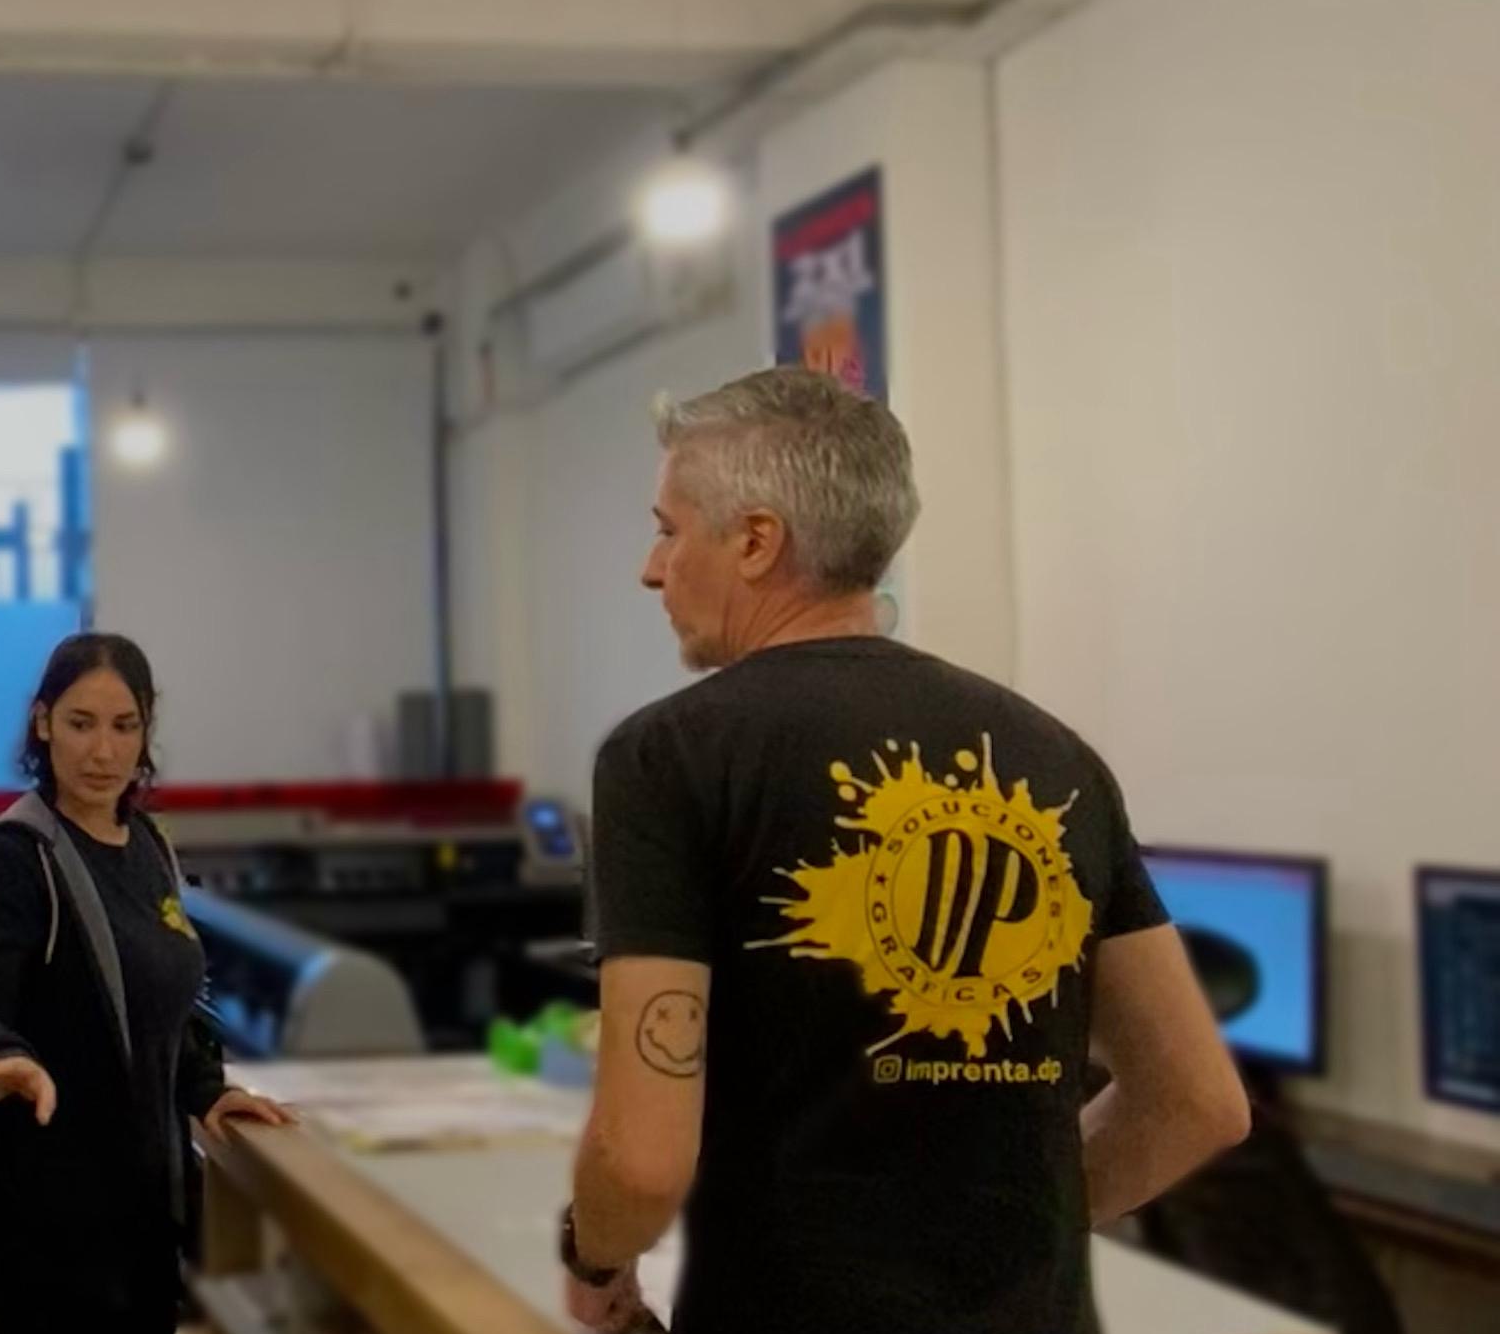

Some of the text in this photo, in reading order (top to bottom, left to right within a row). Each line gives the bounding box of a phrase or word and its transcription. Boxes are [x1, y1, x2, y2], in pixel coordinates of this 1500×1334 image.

[886, 800, 1061, 918] SOLUCIONES
[911, 828, 1039, 978] DP
[871, 901, 1043, 1002] GRAFICAS
